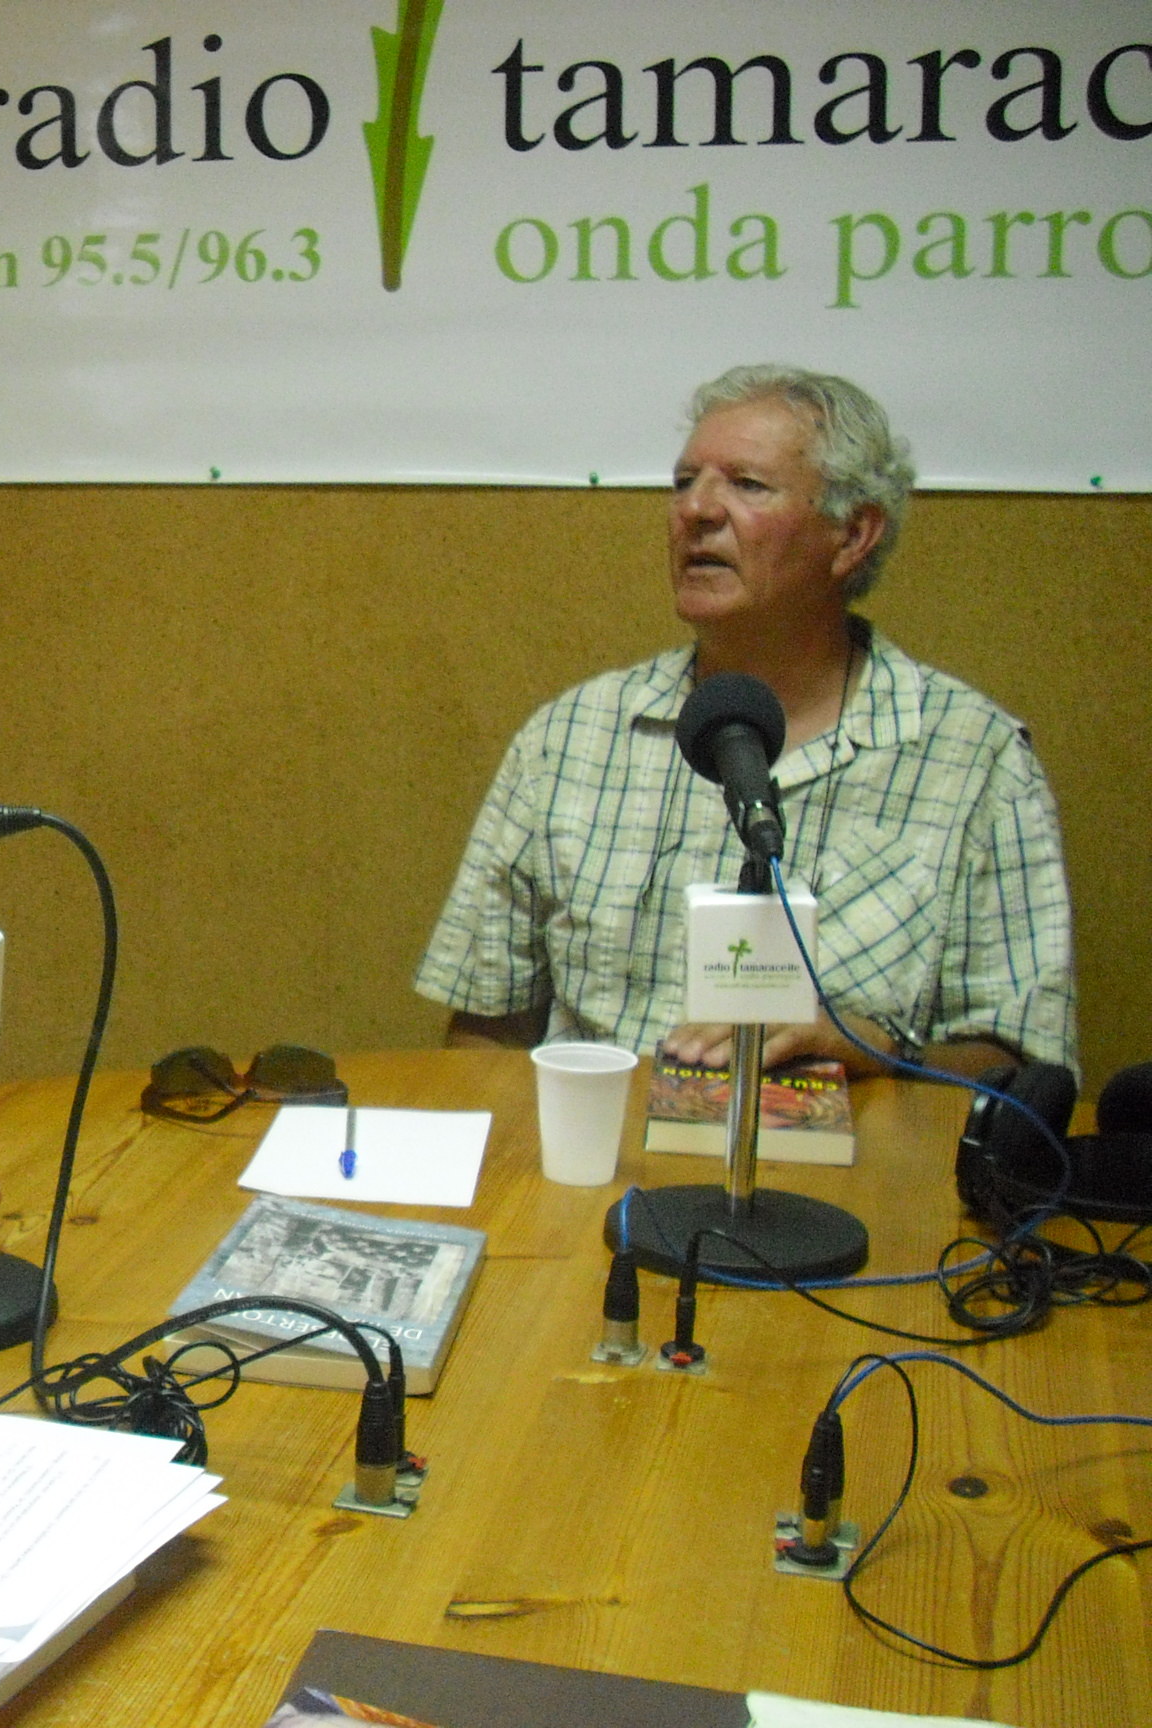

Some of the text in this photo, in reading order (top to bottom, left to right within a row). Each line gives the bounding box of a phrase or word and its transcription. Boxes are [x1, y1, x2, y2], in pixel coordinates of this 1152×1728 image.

[491, 38, 1152, 152] tamarac
[41, 227, 321, 289] 95.5/96.3
[495, 181, 1152, 309] onda parro
[703, 963, 730, 972] radio
[390, 1325, 423, 1340] DE
